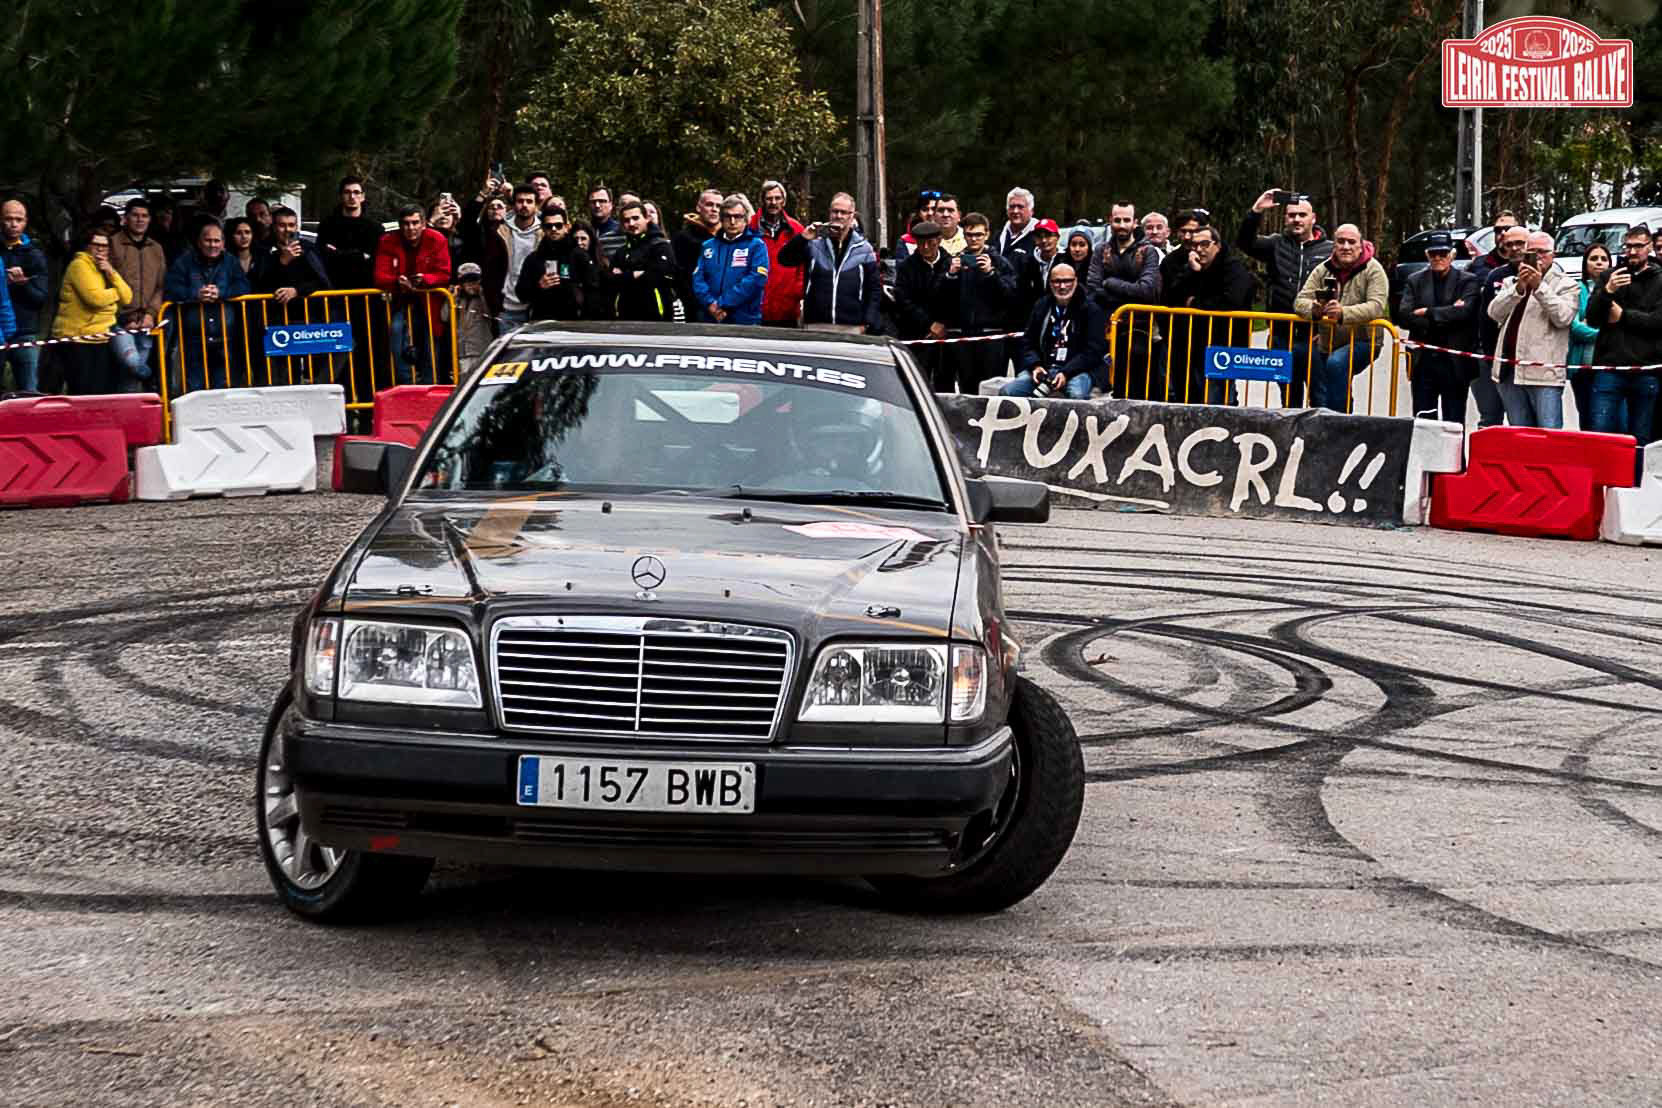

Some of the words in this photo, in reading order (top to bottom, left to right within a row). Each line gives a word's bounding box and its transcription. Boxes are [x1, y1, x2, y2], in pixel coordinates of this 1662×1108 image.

[292, 328, 344, 340] Oliveiras
[1233, 354, 1284, 367] Oliveiras
[524, 785, 533, 796] E
[554, 764, 649, 803] 1157
[667, 768, 743, 807] BWB
